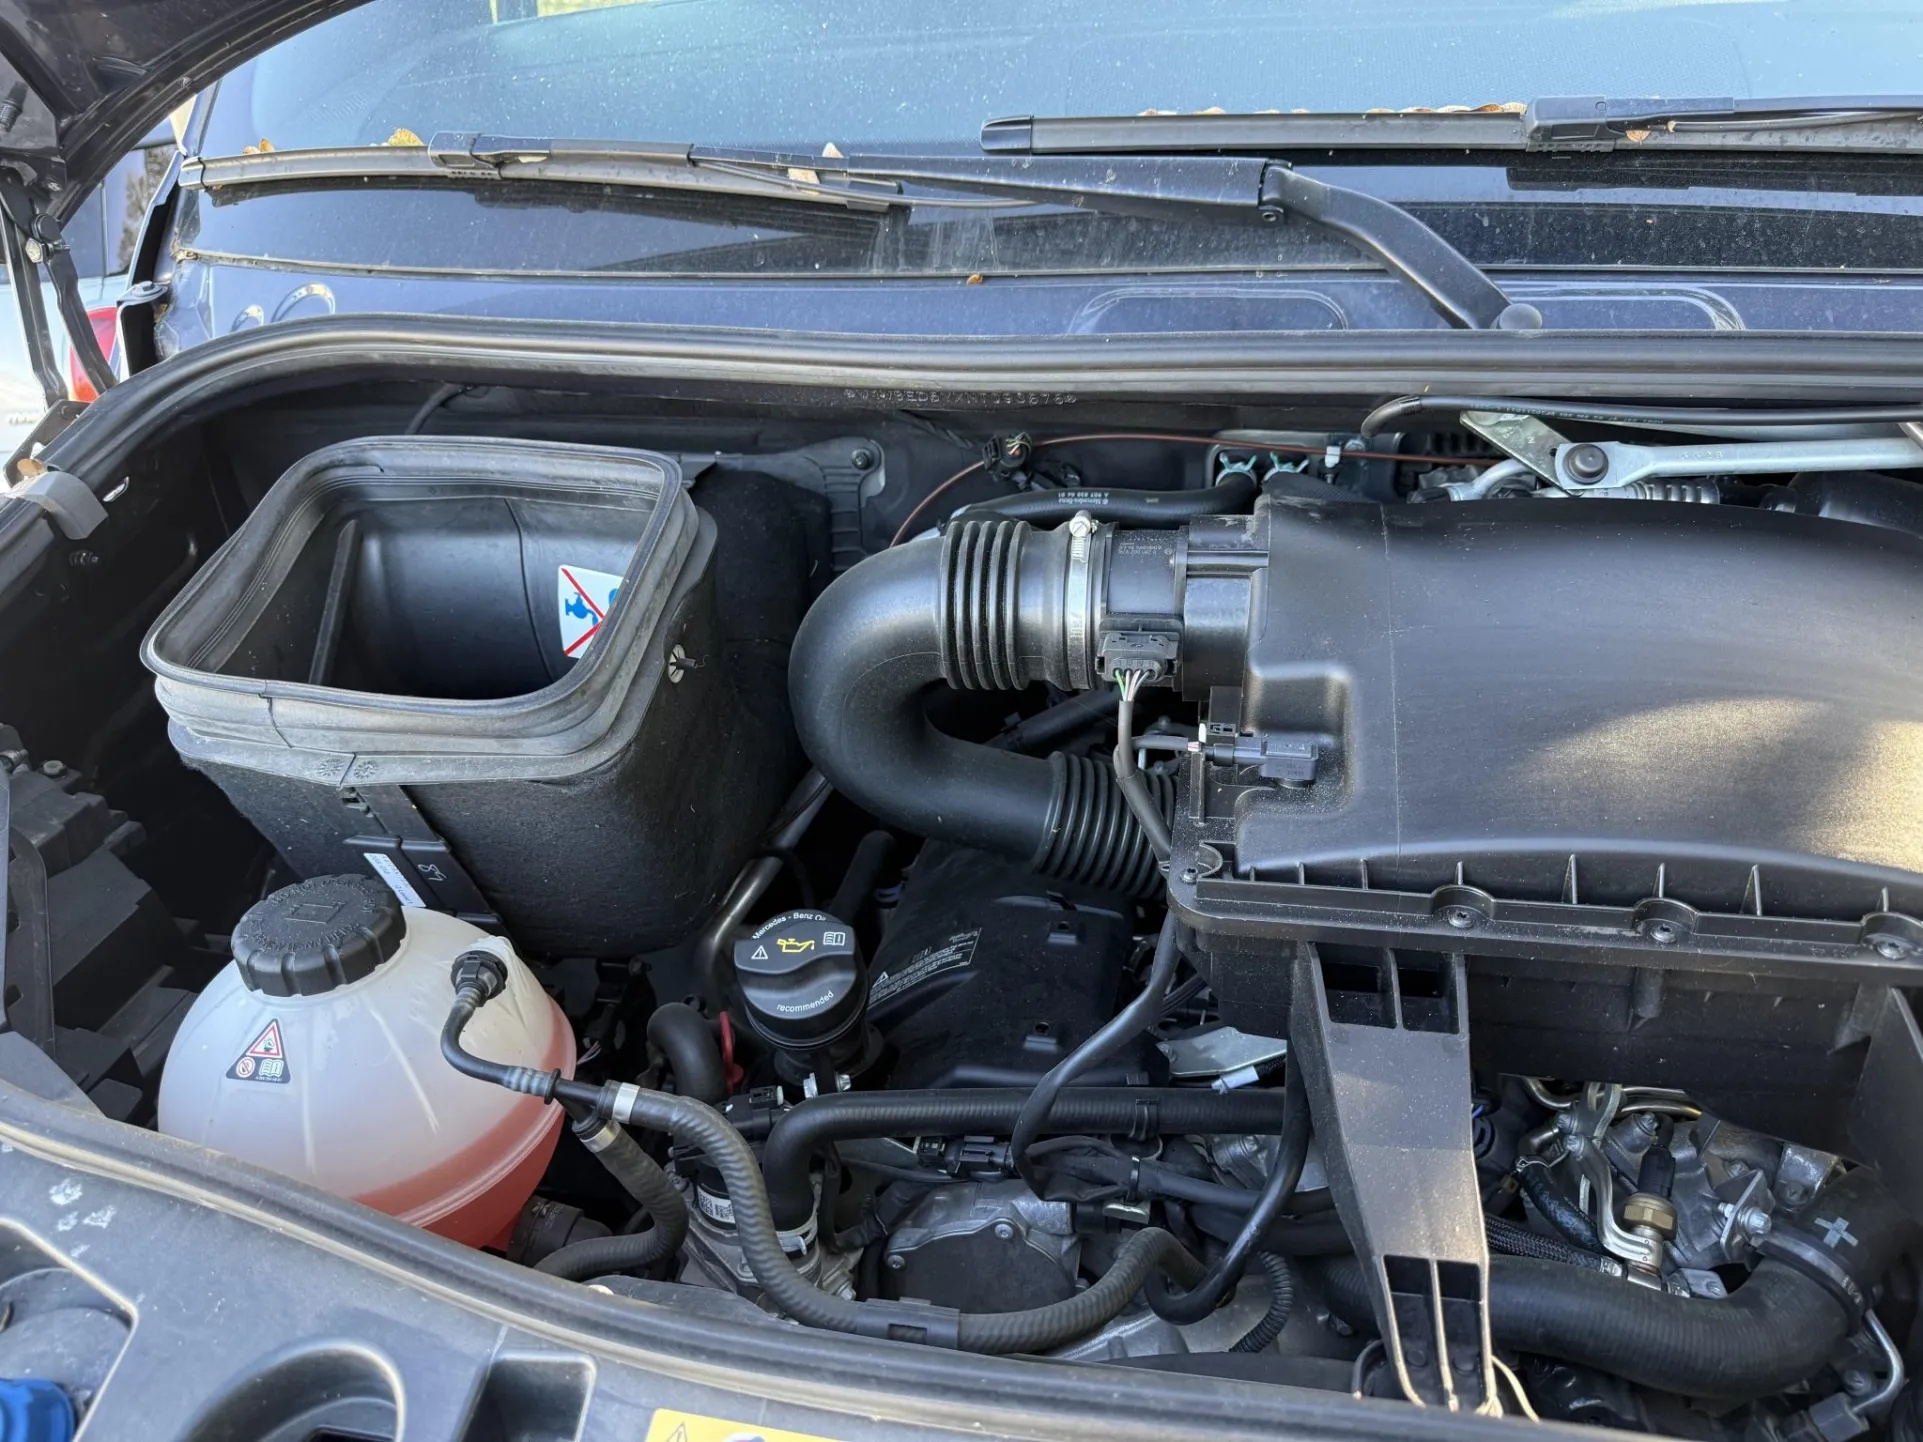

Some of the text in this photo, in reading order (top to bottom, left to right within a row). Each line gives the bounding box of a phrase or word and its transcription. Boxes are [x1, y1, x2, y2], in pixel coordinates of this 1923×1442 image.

[752, 916, 787, 940] Mercedes
[793, 912, 813, 920] Benz
[776, 990, 834, 1012] recommended
